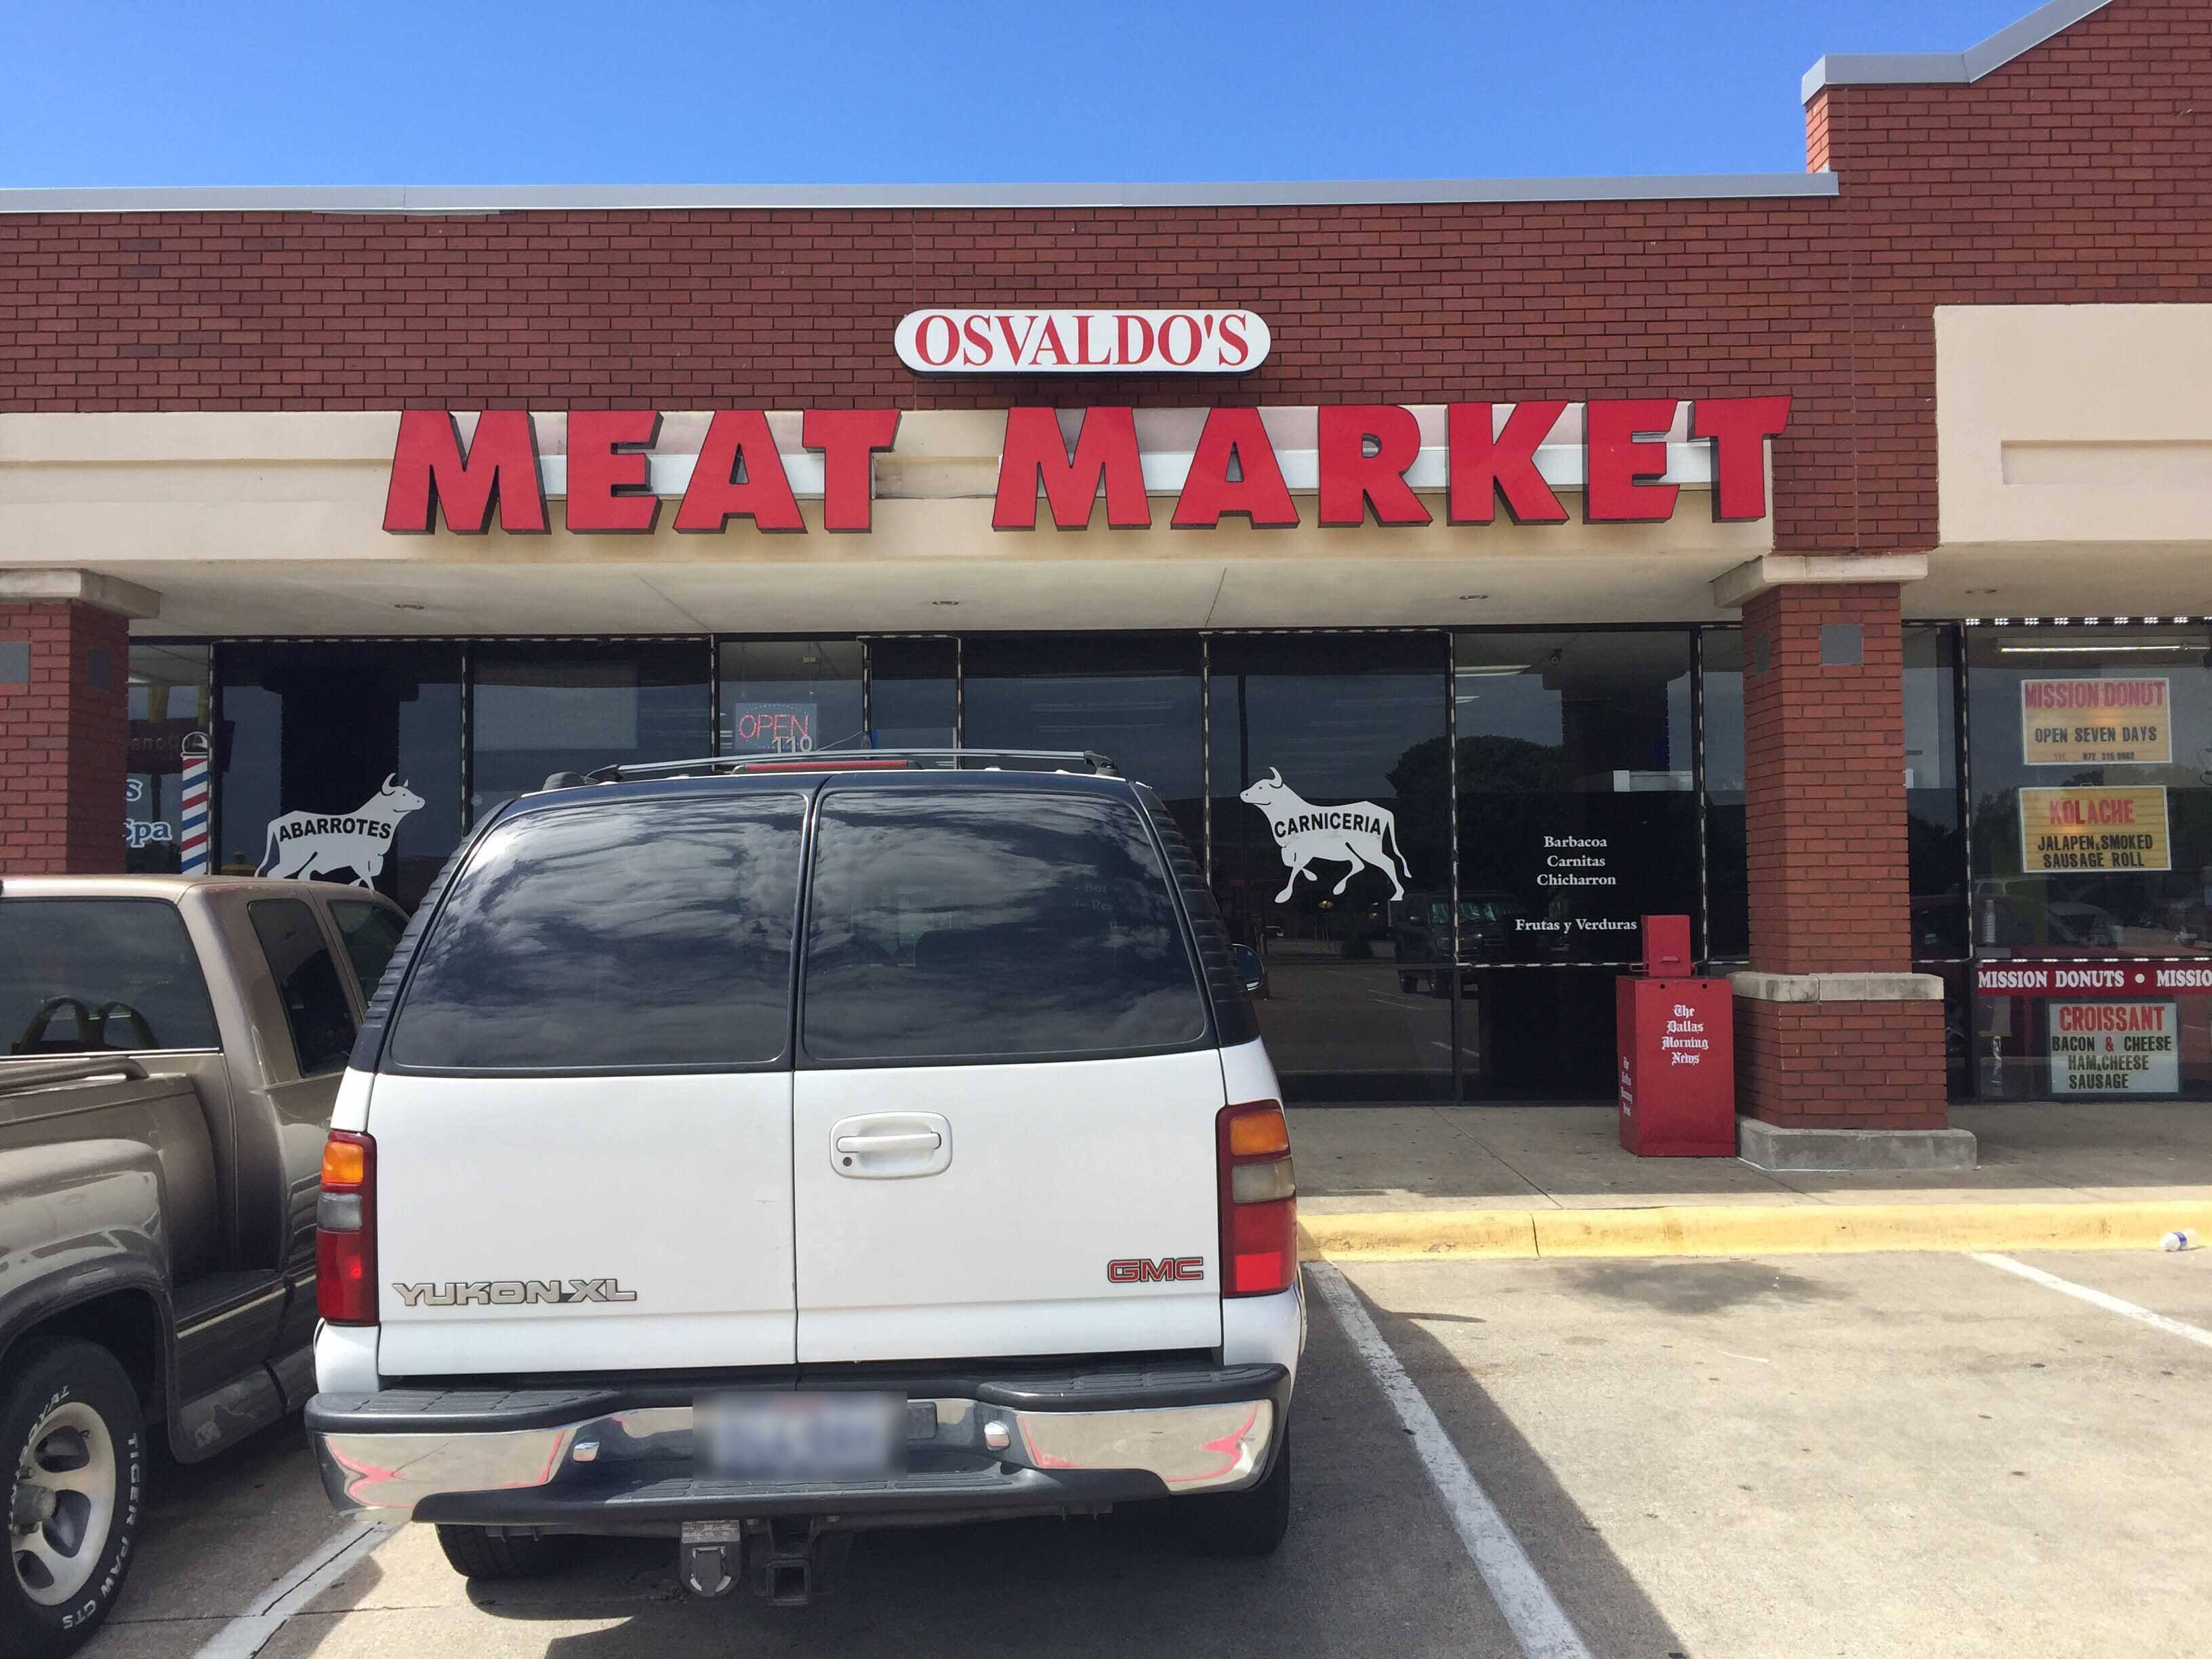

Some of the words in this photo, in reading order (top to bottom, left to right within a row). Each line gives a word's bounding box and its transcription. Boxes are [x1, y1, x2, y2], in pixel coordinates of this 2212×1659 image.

[915, 314, 1249, 367] OSVALDO'S
[382, 409, 901, 534] MEAT
[991, 396, 1792, 531] MARKET
[2024, 682, 2098, 708] MISSION
[2104, 682, 2165, 707] DONUT
[739, 714, 808, 739] OPEN
[2035, 727, 2068, 743] OPEN
[2075, 727, 2116, 743] SEVEN
[2123, 726, 2157, 741] DAYS
[772, 736, 813, 754] 110
[2049, 800, 2135, 825] KOLACHE
[279, 817, 392, 842] ABARROTES
[1274, 813, 1380, 838] CARNICERIA
[1544, 836, 1607, 848] Barbacoa
[1547, 855, 1605, 867] Carnitas
[2043, 853, 2104, 868] SAUSAGE
[2111, 852, 2145, 867] ROLL
[1536, 874, 1616, 886] Chicharron
[1515, 919, 1559, 931] Frutas
[1563, 922, 1572, 934] y
[1576, 918, 1637, 930] Verduras
[1978, 971, 2047, 988] MISSION
[2055, 970, 2125, 987] DONUTS
[1673, 1004, 1695, 1019] The
[2060, 1006, 2165, 1031] CROISSANT
[1666, 1020, 1704, 1034] Dallas
[1662, 1036, 1709, 1050] Morning
[2052, 1036, 2095, 1052] BACON
[2105, 1036, 2114, 1052] &
[2124, 1036, 2171, 1051] CHEESE
[1671, 1052, 1700, 1066] News
[2069, 1073, 2129, 1089] SAUSAGE
[1107, 1256, 1204, 1283] GMC
[391, 1280, 561, 1306] YUKON
[568, 1279, 636, 1303] XL
[126, 1433, 140, 1525] TIGER
[101, 1536, 129, 1597] PAW
[62, 1599, 96, 1629] GTS
